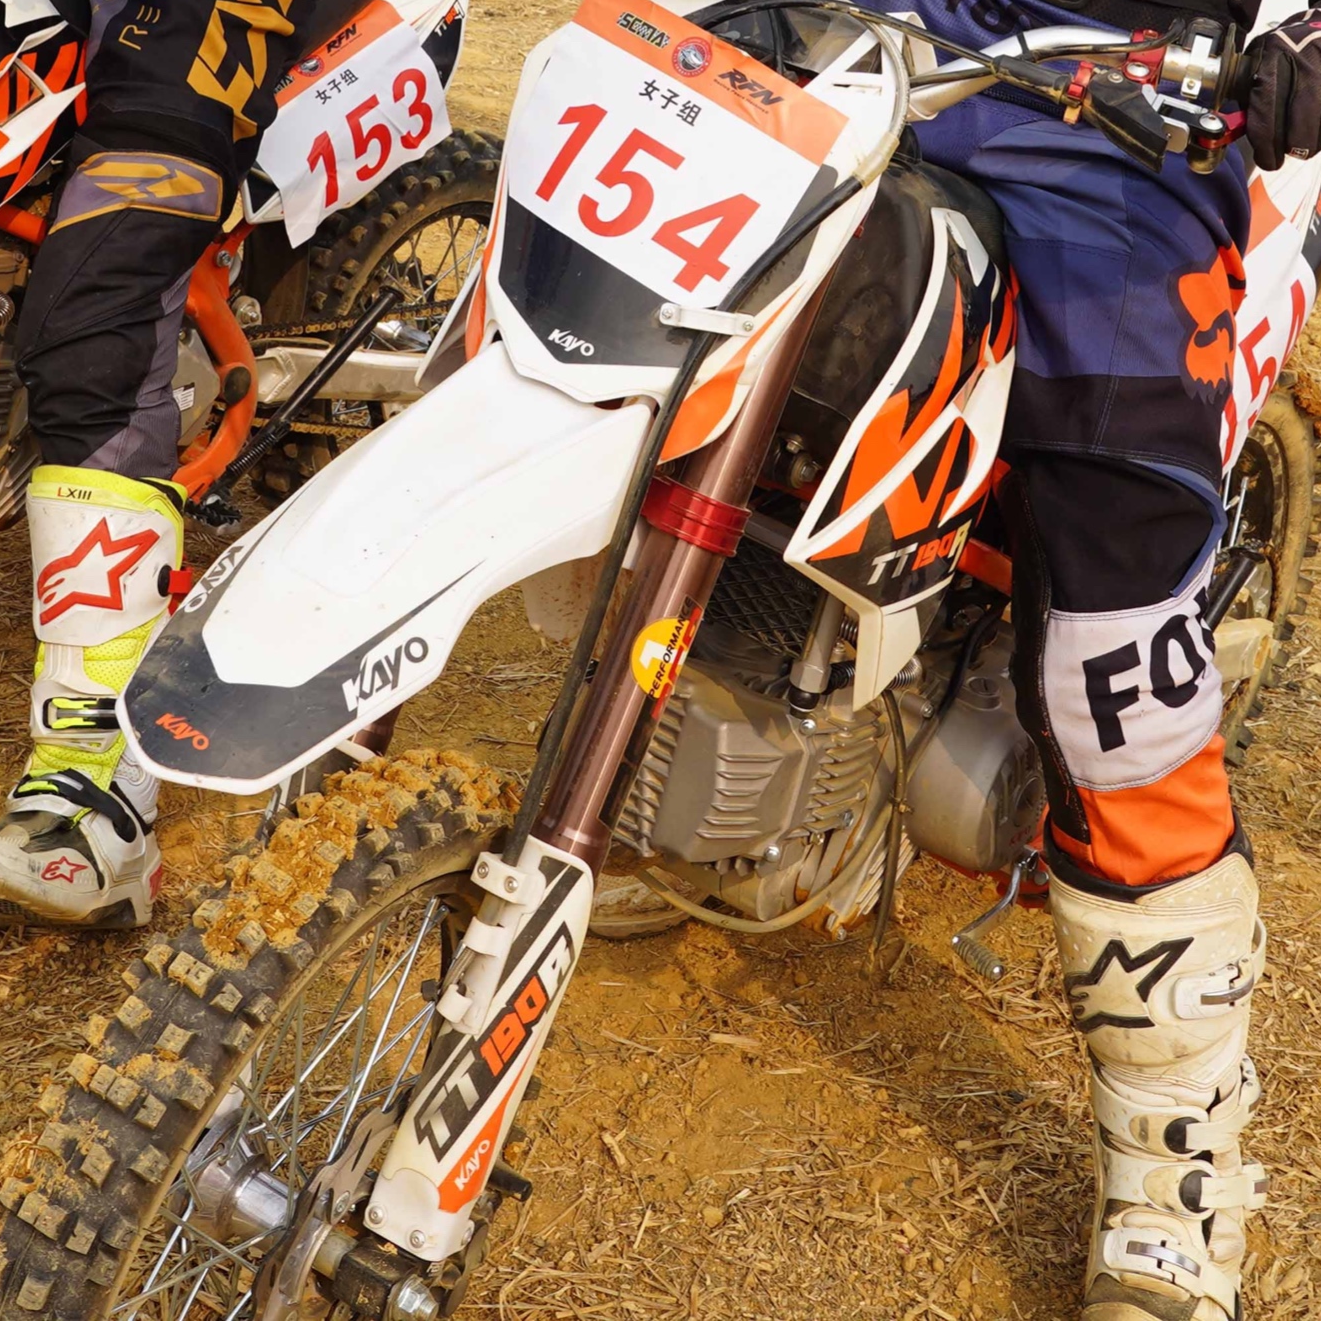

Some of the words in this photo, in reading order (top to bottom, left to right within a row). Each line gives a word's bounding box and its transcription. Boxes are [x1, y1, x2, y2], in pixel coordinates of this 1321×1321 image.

[326, 23, 357, 54] RFN
[315, 68, 359, 105] 女子组
[639, 79, 702, 127] 女子组
[718, 68, 785, 107] RFN
[306, 68, 435, 209] 153
[535, 101, 762, 294] 154
[548, 326, 595, 358] KAYO
[56, 485, 93, 502] LXIII
[342, 635, 428, 712] KAYO
[647, 597, 693, 699] PERFORMANCE
[1081, 586, 1215, 754] FO
[155, 711, 210, 752] KAYO
[415, 930, 573, 1156] TT190R
[454, 1137, 491, 1191] KAYO
